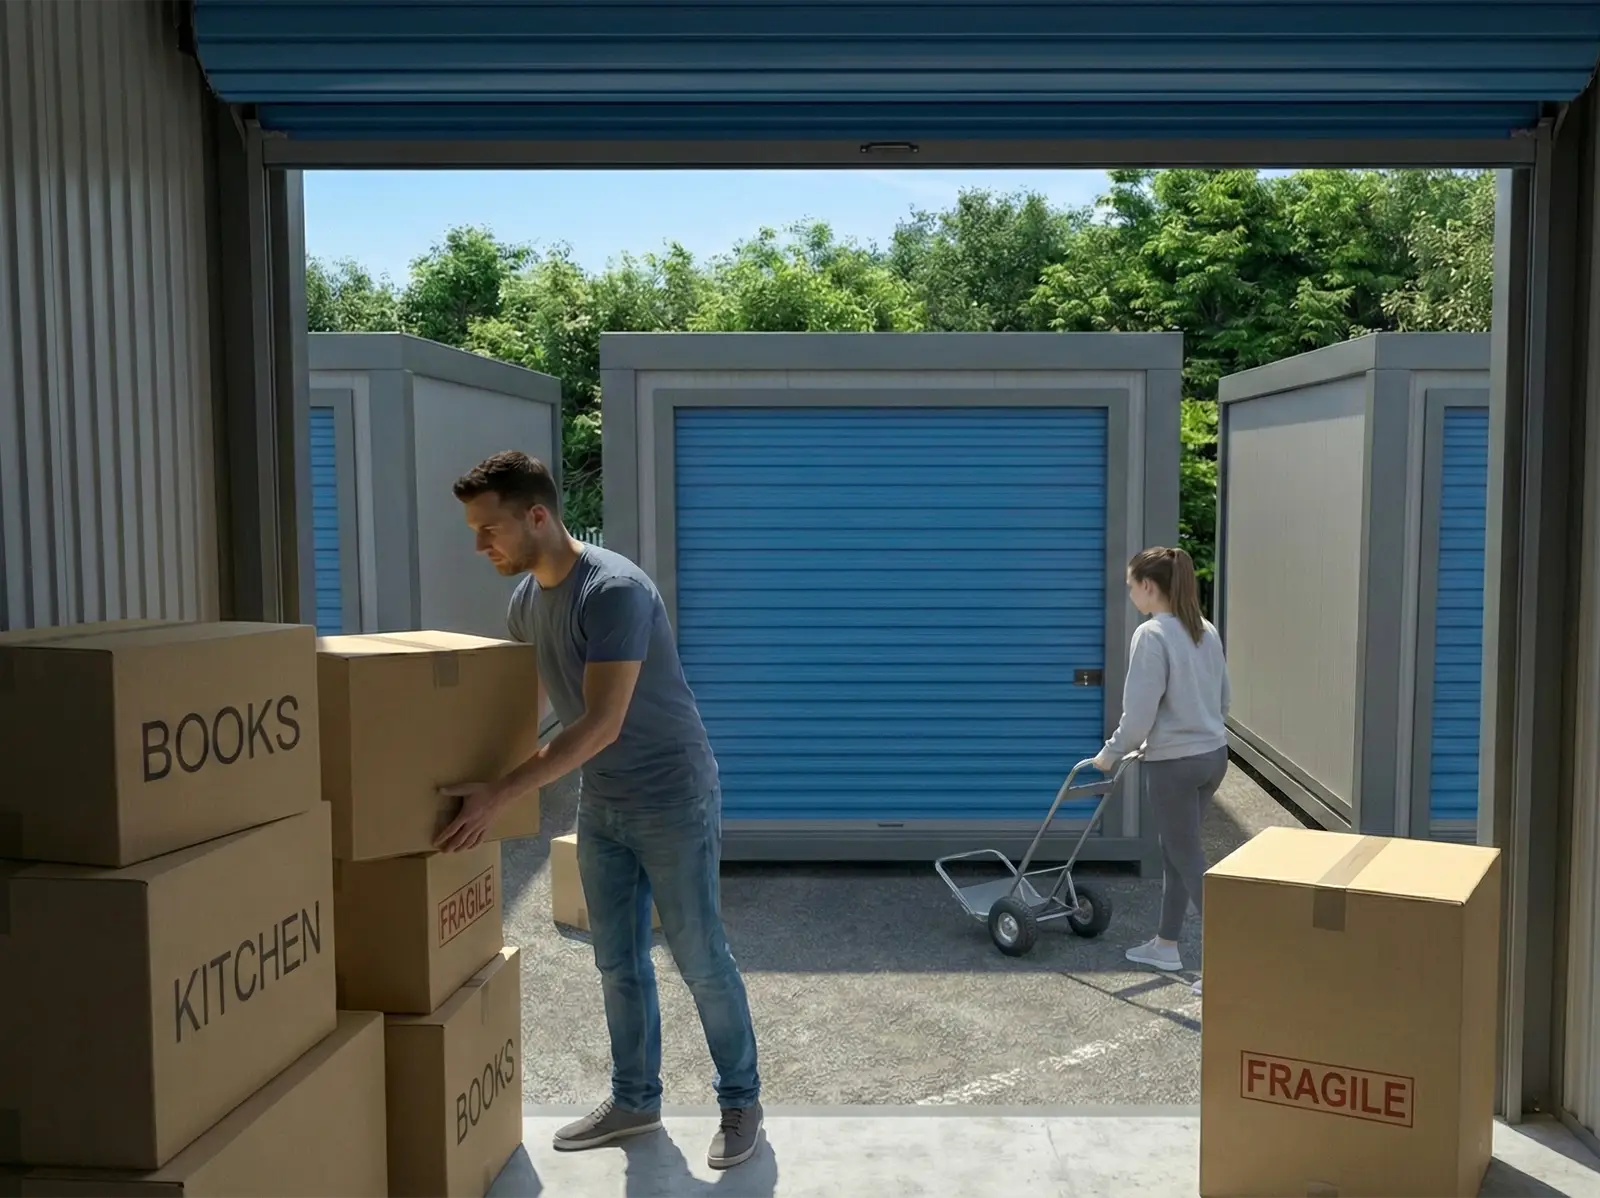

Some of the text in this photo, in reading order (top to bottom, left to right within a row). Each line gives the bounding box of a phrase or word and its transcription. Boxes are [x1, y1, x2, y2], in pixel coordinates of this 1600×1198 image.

[142, 695, 301, 782] BOOKS
[440, 873, 493, 941] FRAGILE
[174, 901, 321, 1043] KITCHEN
[456, 1038, 515, 1146] BOOKS
[1247, 1059, 1406, 1119] FRAGILE
